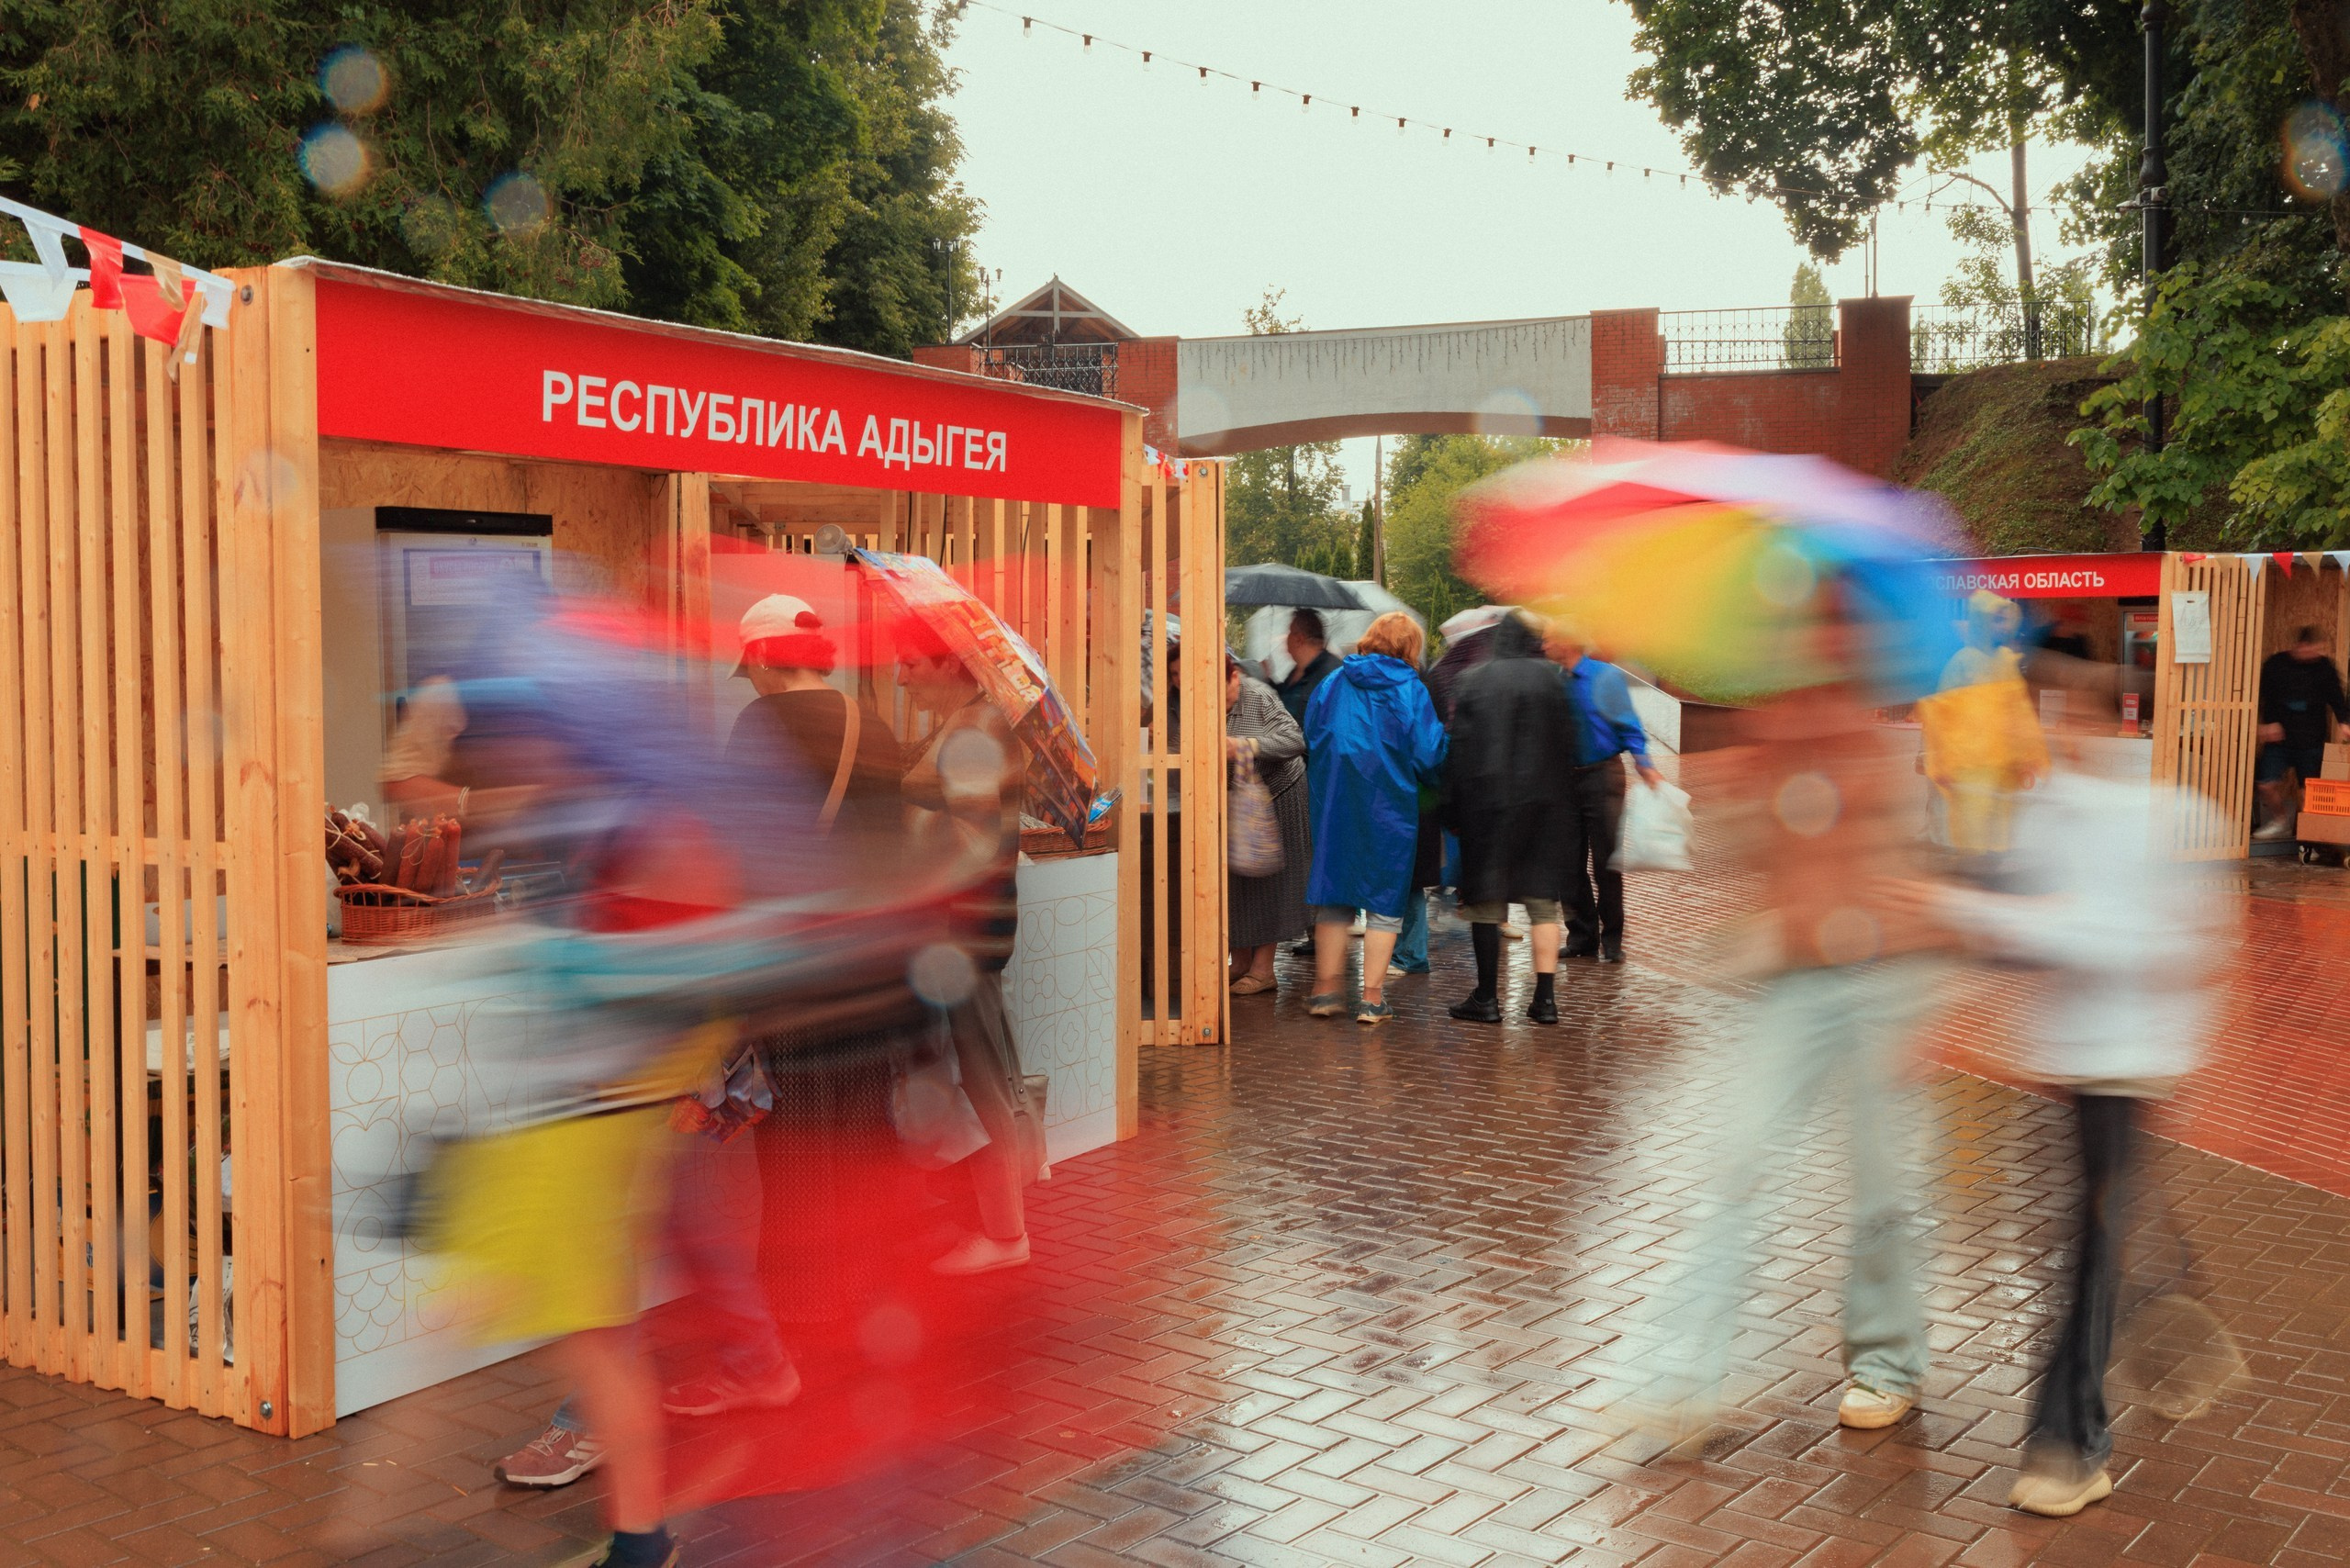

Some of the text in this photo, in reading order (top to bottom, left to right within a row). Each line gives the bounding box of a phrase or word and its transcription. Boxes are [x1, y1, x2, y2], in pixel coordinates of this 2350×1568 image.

[543, 370, 1007, 472] РЕСПУБЛИКА АДЫГЕЯ
[2023, 571, 2105, 588] ОБЛАСТЬ
